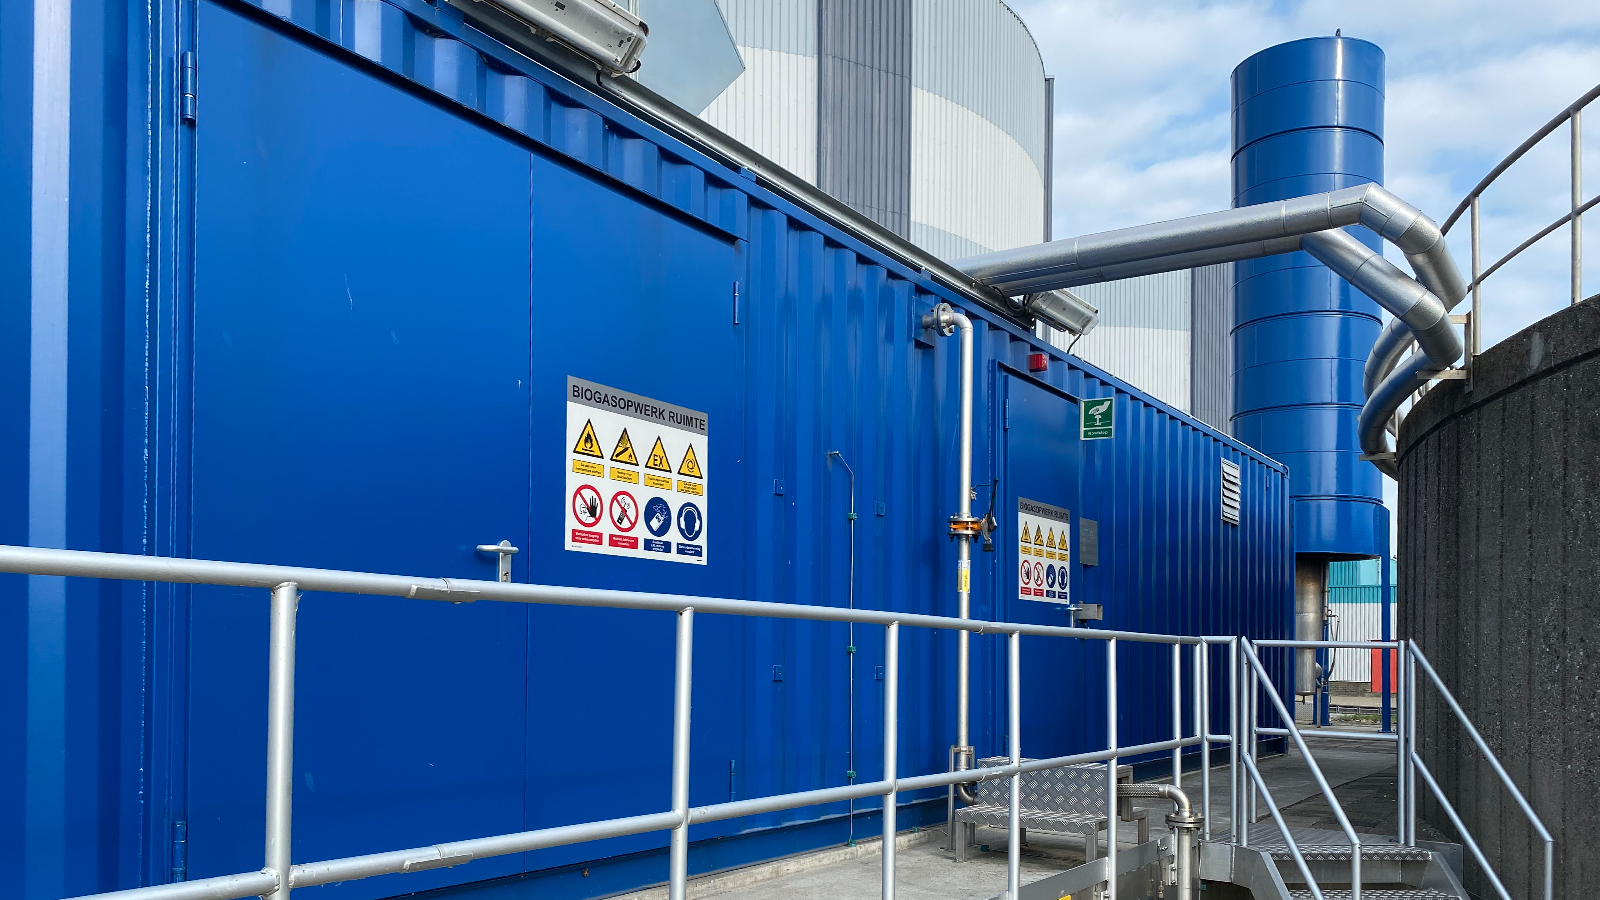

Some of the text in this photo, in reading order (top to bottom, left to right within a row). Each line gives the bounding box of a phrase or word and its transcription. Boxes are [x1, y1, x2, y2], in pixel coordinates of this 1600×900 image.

[572, 384, 706, 431] BIOGASOPWERK RUIMTE
[653, 454, 664, 468] EX
